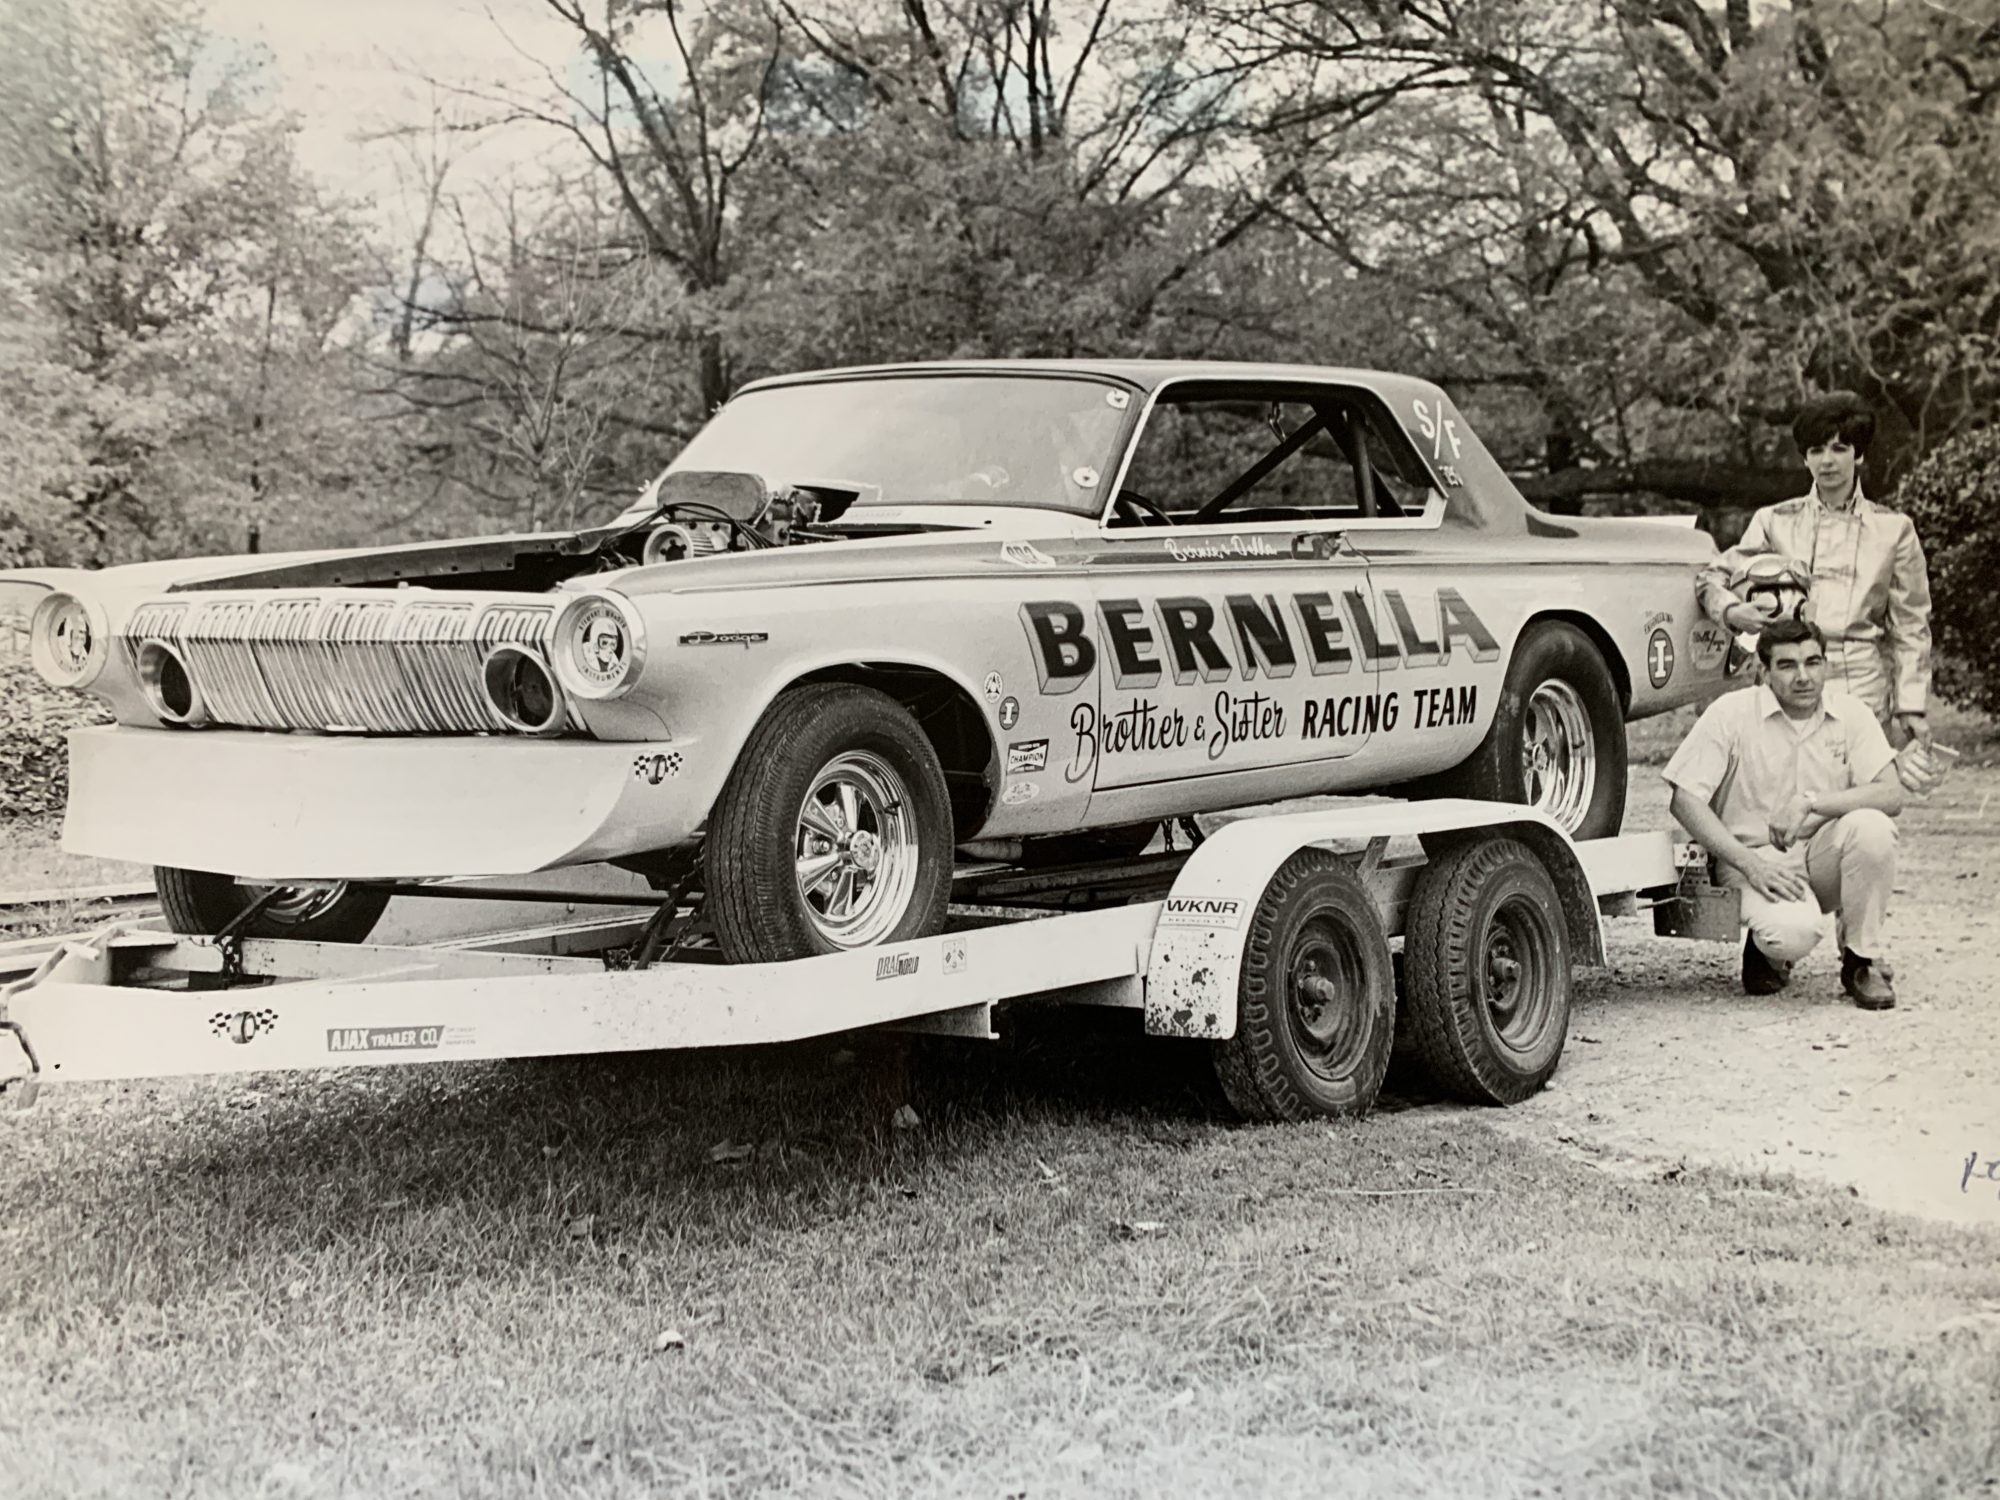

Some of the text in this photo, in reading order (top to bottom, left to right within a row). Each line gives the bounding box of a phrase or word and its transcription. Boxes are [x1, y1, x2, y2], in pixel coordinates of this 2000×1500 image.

[1413, 399, 1461, 459] S/F
[1018, 587, 1500, 695] BERNELLA
[1065, 697, 1188, 783] Brother
[1208, 691, 1287, 761] Sister
[1301, 692, 1399, 740] RACING
[1414, 685, 1477, 729] TEAM
[1010, 752, 1044, 764] CHAMPION
[1167, 900, 1238, 914] WKNR
[331, 1029, 369, 1050] AJAX
[371, 1031, 417, 1047] TRAILER
